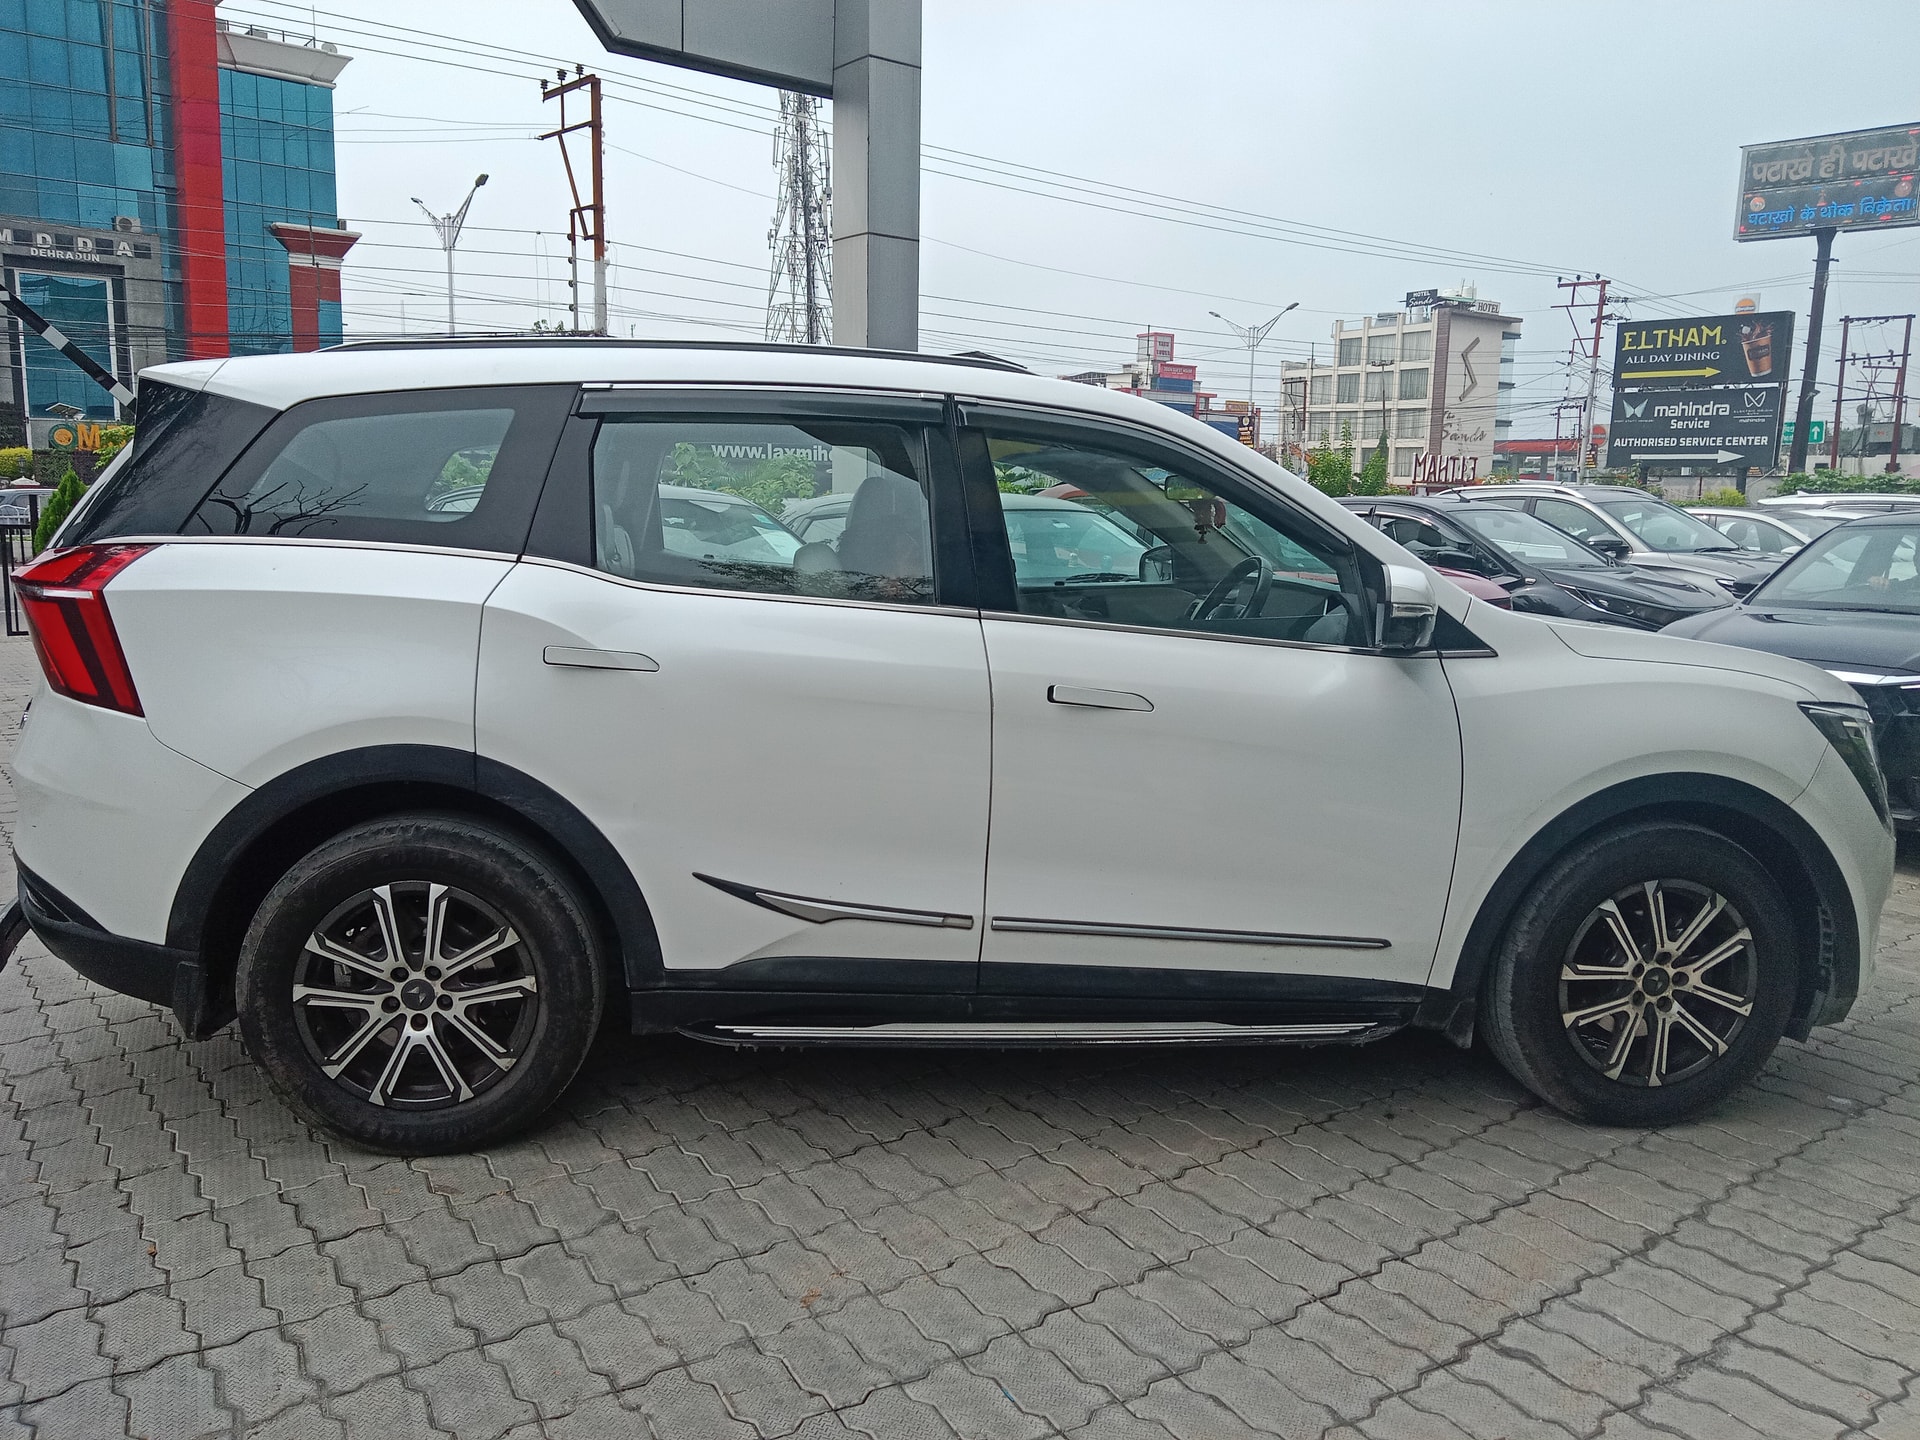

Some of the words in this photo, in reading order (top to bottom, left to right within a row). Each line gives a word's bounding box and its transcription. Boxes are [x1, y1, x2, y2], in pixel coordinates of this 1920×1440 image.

[1753, 149, 1815, 182] पटाखे
[1819, 145, 1847, 178] ही
[1800, 203, 1817, 220] के
[1820, 201, 1855, 218] थोक
[30, 247, 100, 262] DEHRADUN
[1477, 302, 1500, 314] HOTEL
[1625, 355, 1647, 364] ALL
[1649, 354, 1672, 363] DAY
[1674, 351, 1720, 362] DINING
[1653, 400, 1730, 417] mahindra
[1670, 417, 1710, 429] Service
[1613, 436, 1677, 447] AUTHORISED
[1679, 436, 1723, 446] SERVICE
[1725, 436, 1768, 446] CENTER
